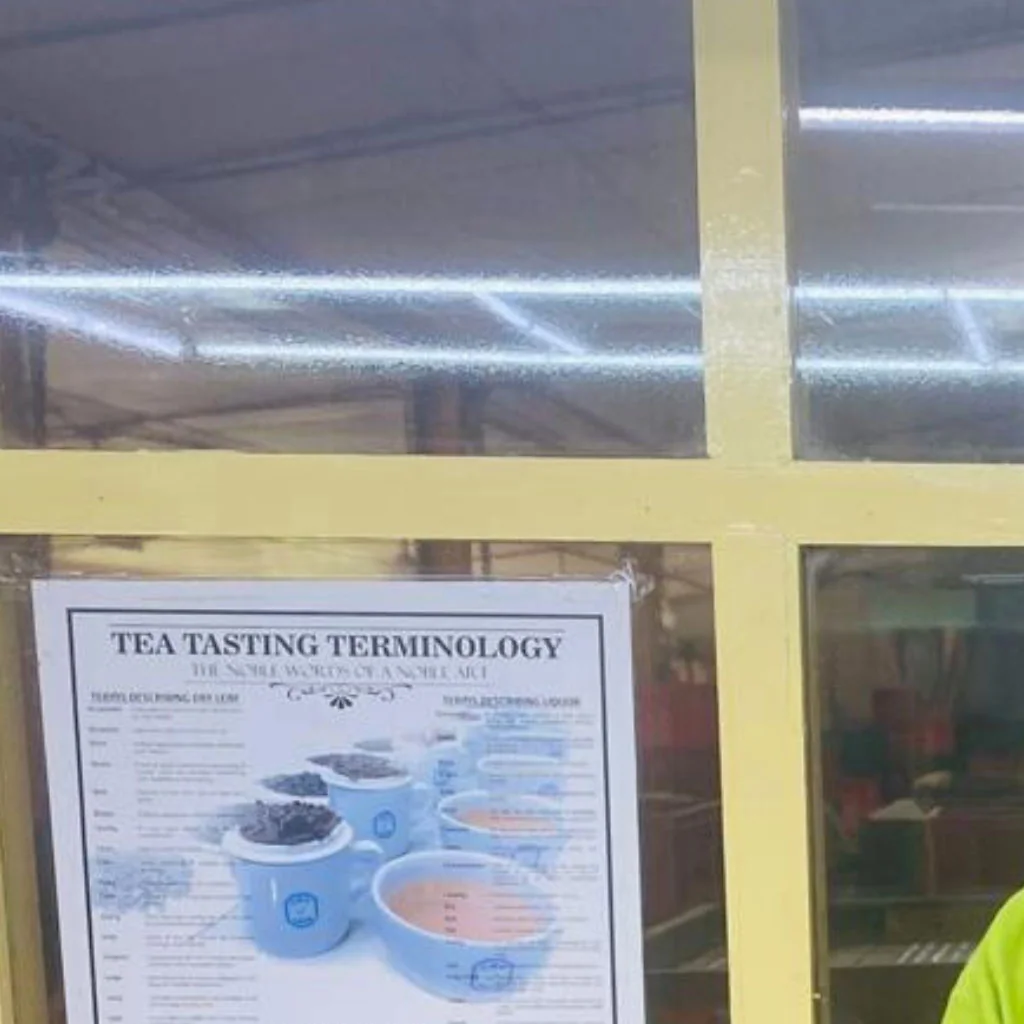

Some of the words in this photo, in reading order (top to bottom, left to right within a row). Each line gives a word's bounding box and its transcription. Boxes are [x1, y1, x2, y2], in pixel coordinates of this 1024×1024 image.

[110, 632, 176, 655] TEA
[183, 632, 319, 657] TASTING
[326, 634, 563, 660] TERMINOLOGY
[190, 663, 218, 677] THE
[226, 663, 277, 678] NOBLE
[284, 664, 349, 679] WORDS
[354, 665, 374, 679] OF
[382, 666, 392, 680] A
[399, 666, 448, 680] NOBLE
